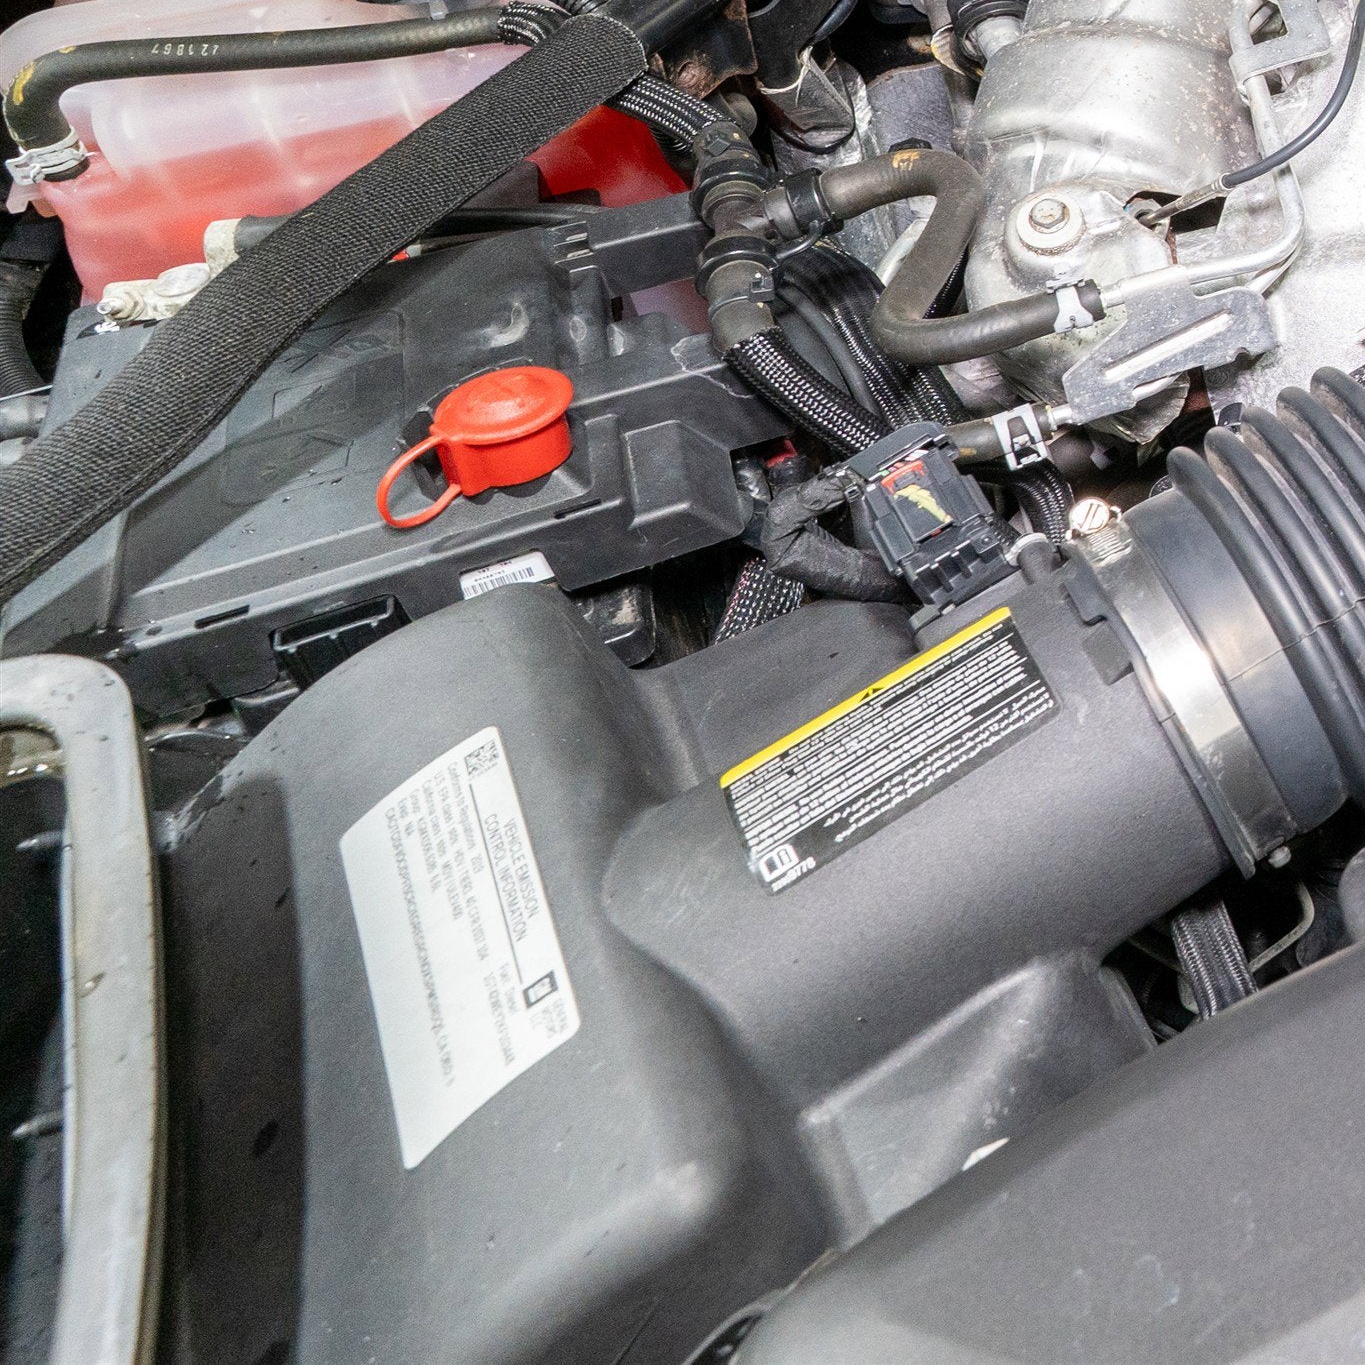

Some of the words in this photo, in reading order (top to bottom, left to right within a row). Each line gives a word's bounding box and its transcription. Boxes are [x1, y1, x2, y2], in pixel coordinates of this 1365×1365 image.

[483, 811, 508, 868] CONTROL
[496, 862, 528, 944] INFORMATION
[503, 817, 525, 866] VEHICLE
[514, 861, 540, 920] EMISSION
